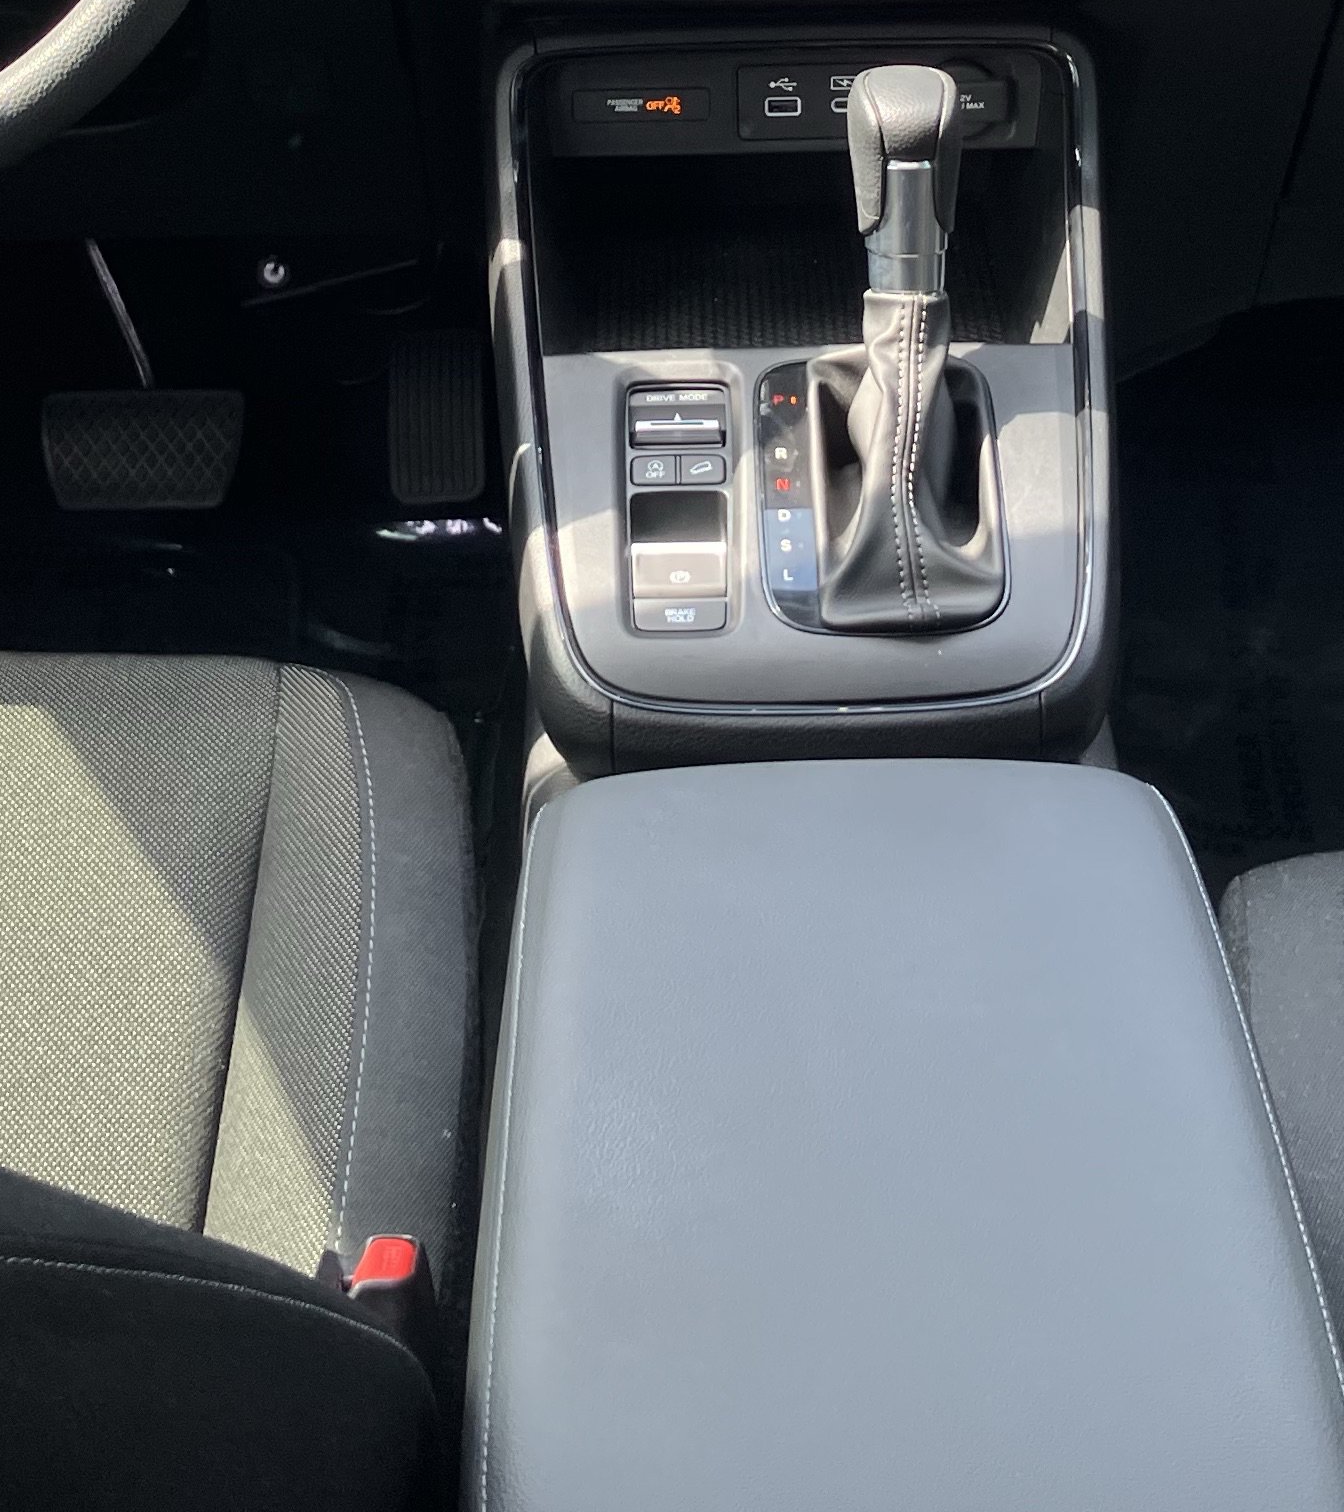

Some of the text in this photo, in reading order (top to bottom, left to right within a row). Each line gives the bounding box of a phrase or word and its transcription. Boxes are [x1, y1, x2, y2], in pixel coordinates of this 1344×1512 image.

[959, 94, 972, 102] 2V
[646, 100, 664, 110] OFF
[966, 101, 985, 109] MAX
[646, 393, 708, 402] DRIVE MODE
[772, 394, 784, 406] P
[774, 446, 788, 460] R
[645, 469, 665, 479] OFF
[776, 478, 790, 491] N
[778, 508, 792, 522] D
[780, 539, 792, 552] S
[783, 568, 794, 581] L
[664, 607, 696, 617] BRAKE
[667, 615, 695, 623] HOLD
